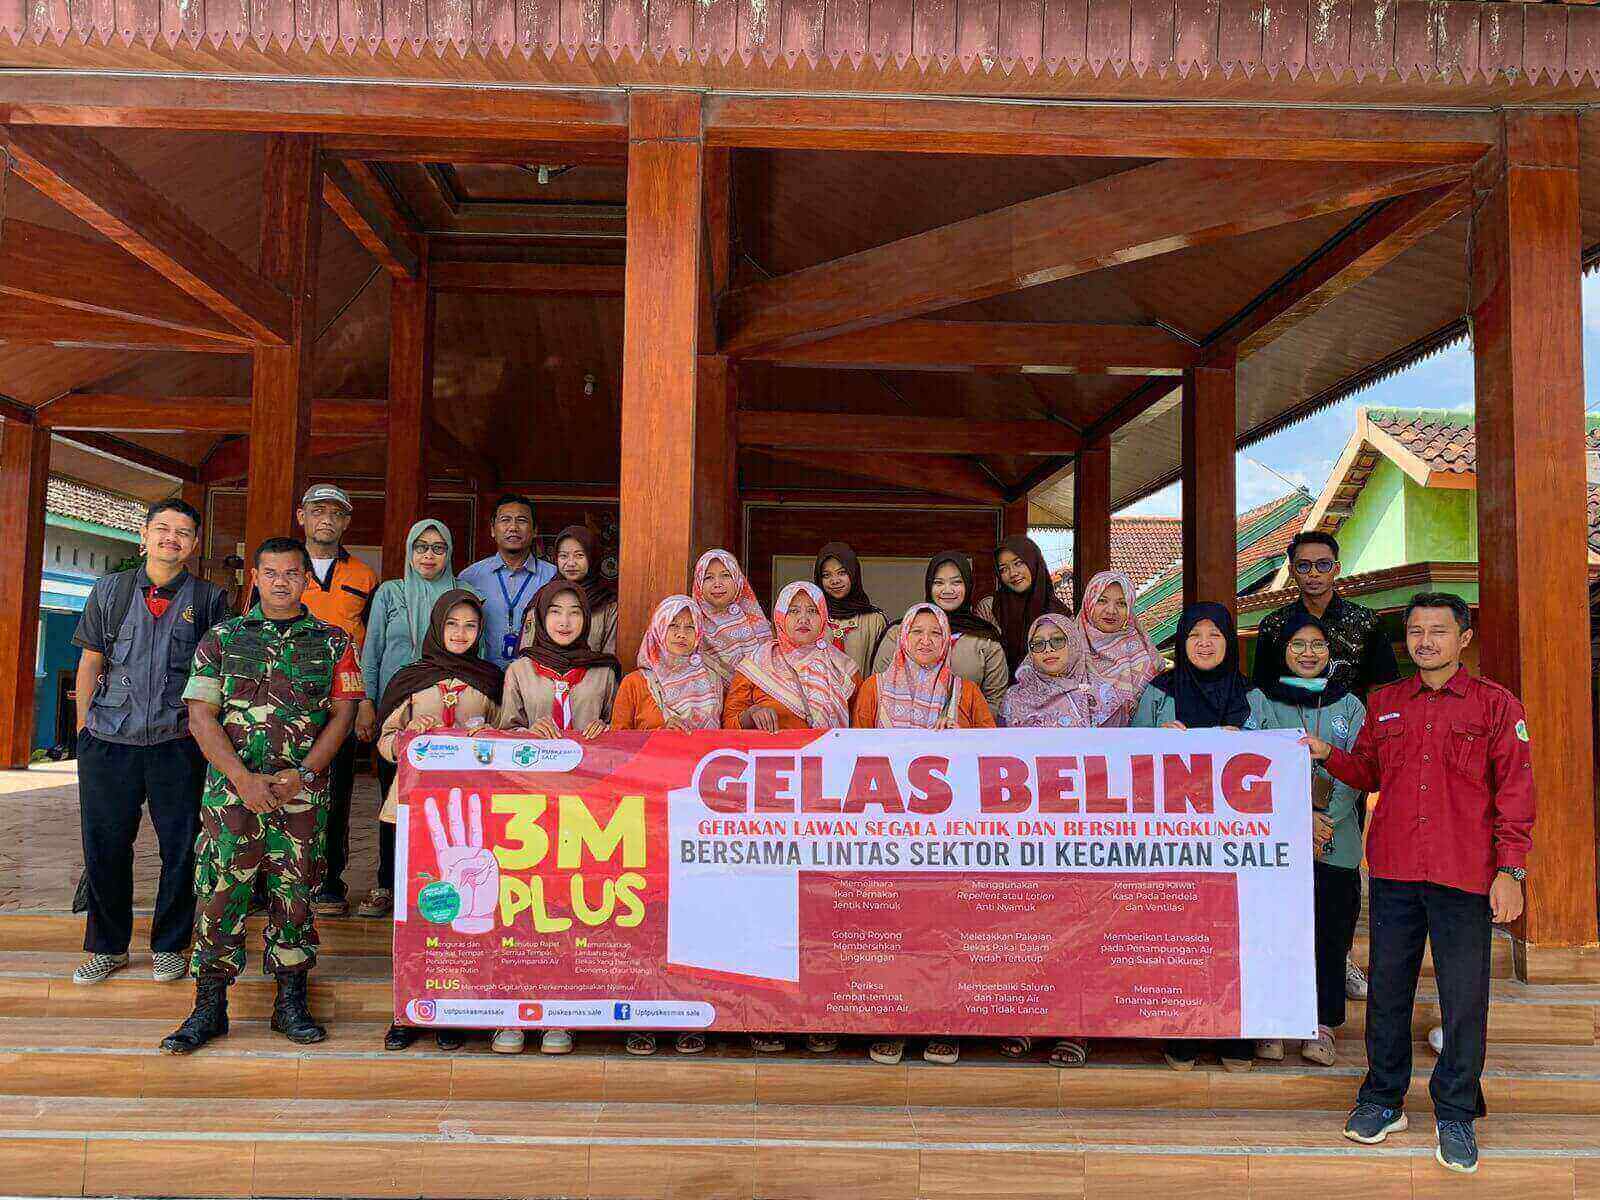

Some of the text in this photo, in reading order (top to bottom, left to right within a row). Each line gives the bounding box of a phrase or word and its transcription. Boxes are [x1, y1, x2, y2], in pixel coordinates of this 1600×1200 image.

[699, 753, 1273, 814] GELAS BELING
[491, 794, 646, 870] 3M
[699, 820, 1271, 837] GERAKAN LAWAN SEGALA JENTIK DAN BERSIH LINGKUNGAN
[680, 839, 1289, 867] BERSAMA LINTAS SEKTOR DI KECAMATAN SALE
[972, 881, 1039, 891] Menggunakan
[1025, 892, 1055, 900] Lotion
[1112, 893, 1198, 902] Kasa Pada Jendela
[499, 872, 647, 933] PLUS
[862, 902, 901, 912] Nyamuk
[1125, 903, 1185, 912] dan Ventilasi
[975, 903, 1036, 913] Anti Nyamuk
[832, 931, 902, 941] Gotong Royong
[960, 933, 1014, 941] Meletakkan
[1103, 933, 1163, 942] Memberikan
[1127, 944, 1198, 955] Penampungan
[840, 953, 895, 963] Lingkungan
[969, 954, 1001, 963] Wadah
[1137, 956, 1164, 965] Susah
[1168, 957, 1204, 966] Dikuras
[426, 979, 460, 990] PLUS
[1135, 985, 1183, 994] Menanam
[1026, 994, 1040, 1002] Air
[1115, 996, 1158, 1005] Tanaman
[826, 1004, 895, 1014] Penampungan
[965, 1005, 1049, 1015] Yang Tidak Lancar
[1139, 1008, 1179, 1018] Nyamuk
